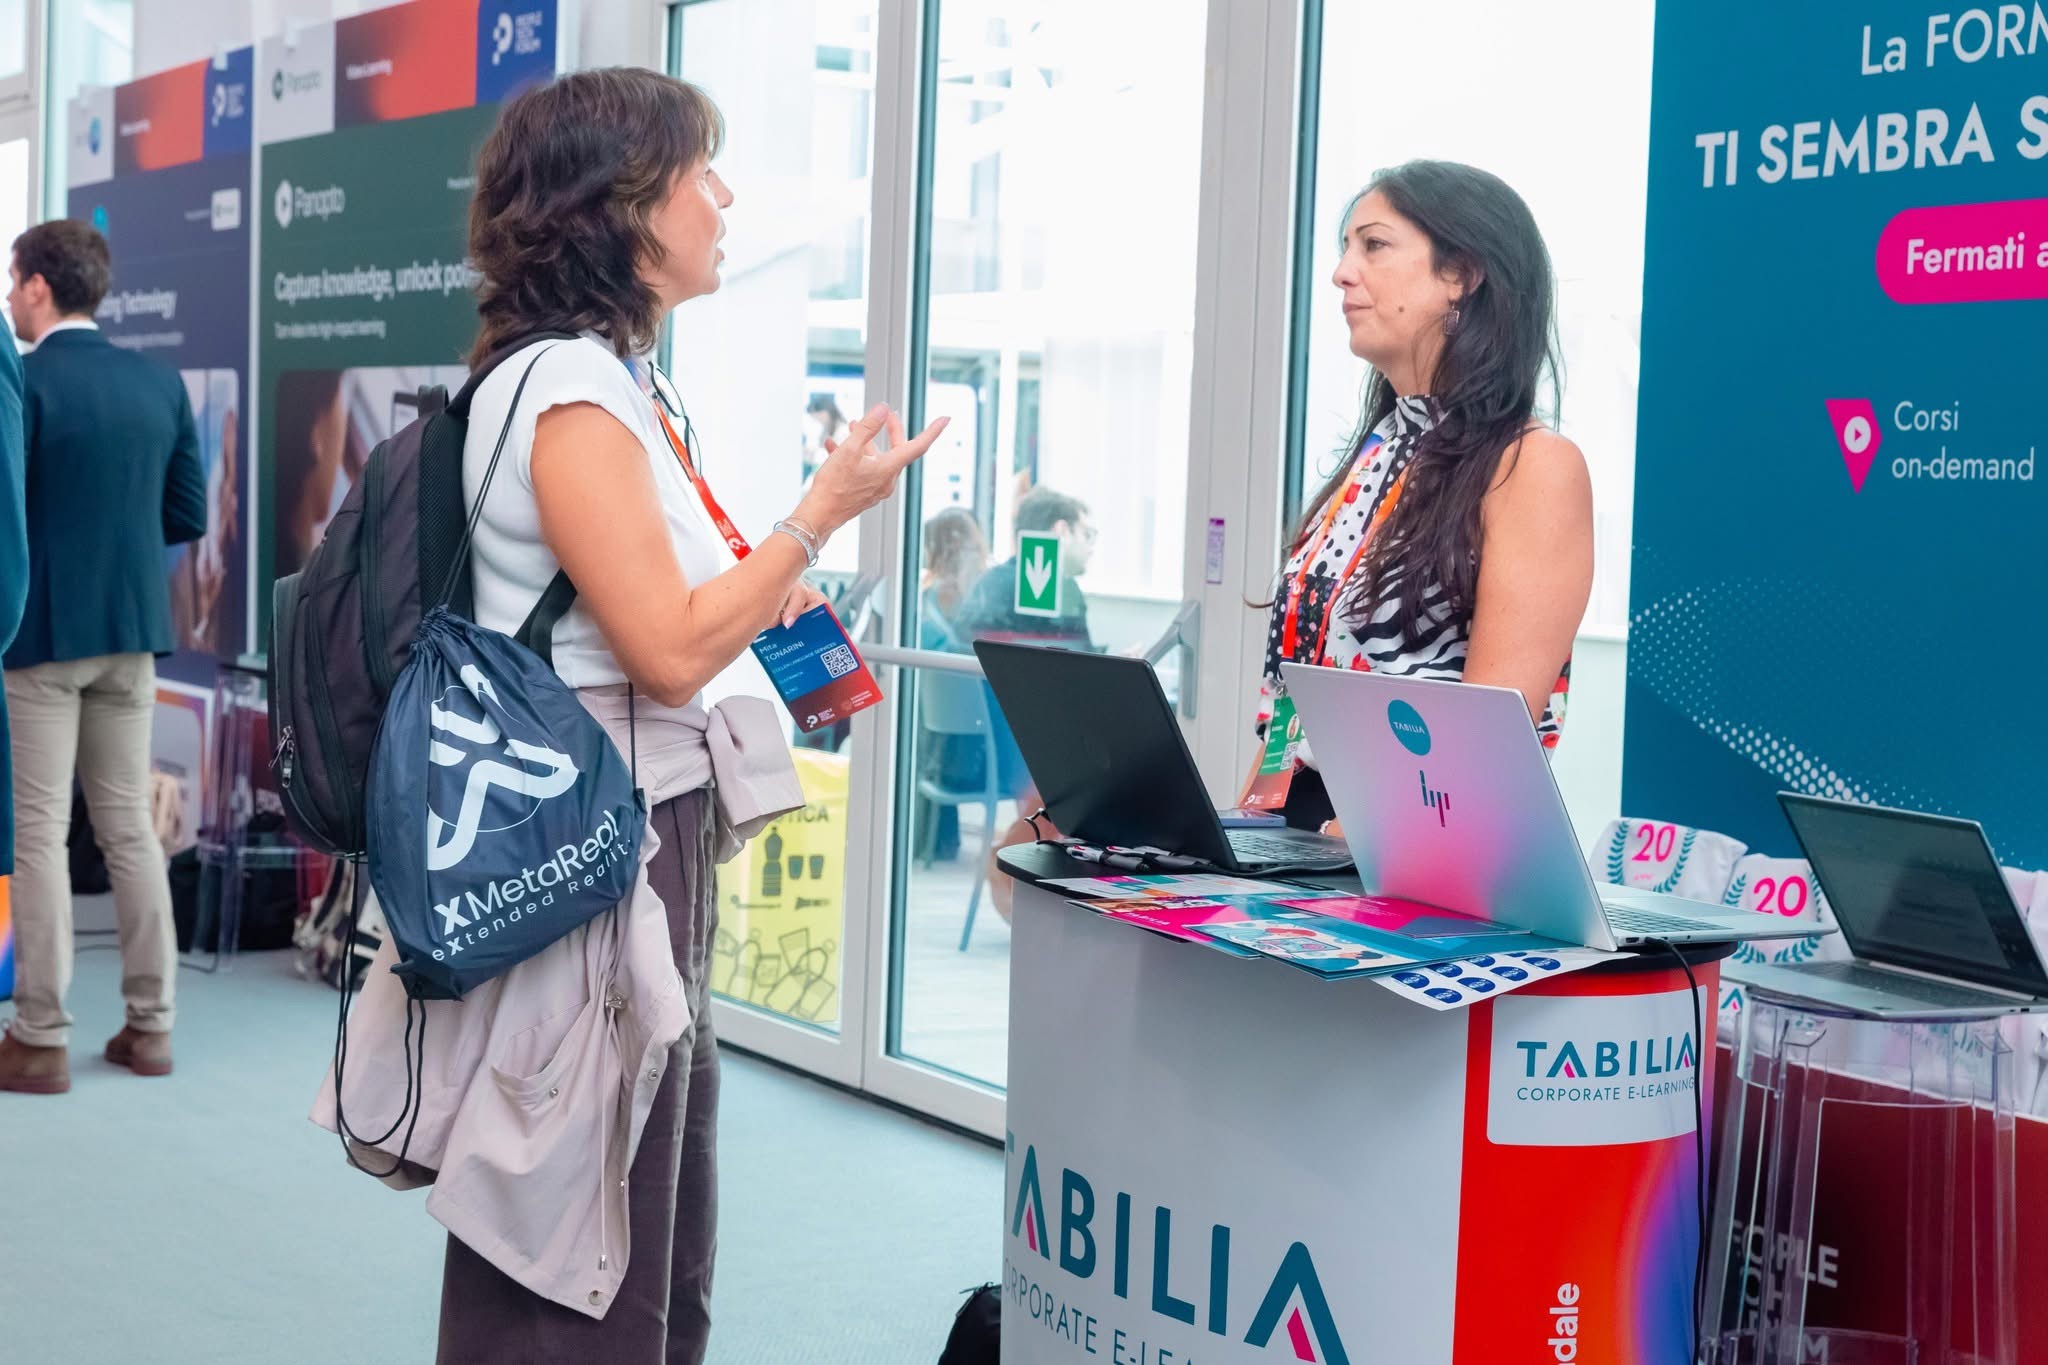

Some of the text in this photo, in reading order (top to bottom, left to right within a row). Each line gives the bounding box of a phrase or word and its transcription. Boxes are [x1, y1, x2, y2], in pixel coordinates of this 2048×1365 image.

[1862, 25, 1907, 76] La
[1695, 130, 1739, 188] TI
[1756, 101, 1995, 184] SEMBRA
[295, 184, 346, 221] Panopto
[1906, 231, 2025, 275] Fermati
[275, 272, 321, 307] Capture
[322, 264, 395, 302] knowledge,
[396, 258, 443, 293] unlock
[121, 287, 177, 320] Technology
[1894, 401, 1959, 431] Corsi
[1892, 446, 2035, 481] on-demand
[759, 643, 778, 655] Mita
[764, 641, 805, 662] TONARINI
[1393, 721, 1425, 735] TABILIA
[1632, 823, 1676, 862] 20
[567, 839, 632, 895] Realit
[1753, 875, 1808, 917] 20
[1516, 1031, 1696, 1078] TABILIA
[1517, 1078, 1695, 1102] CORPORATE E-LEARNING
[1004, 1257, 1097, 1354] ORPORATE
[1547, 1282, 1580, 1365] dale
